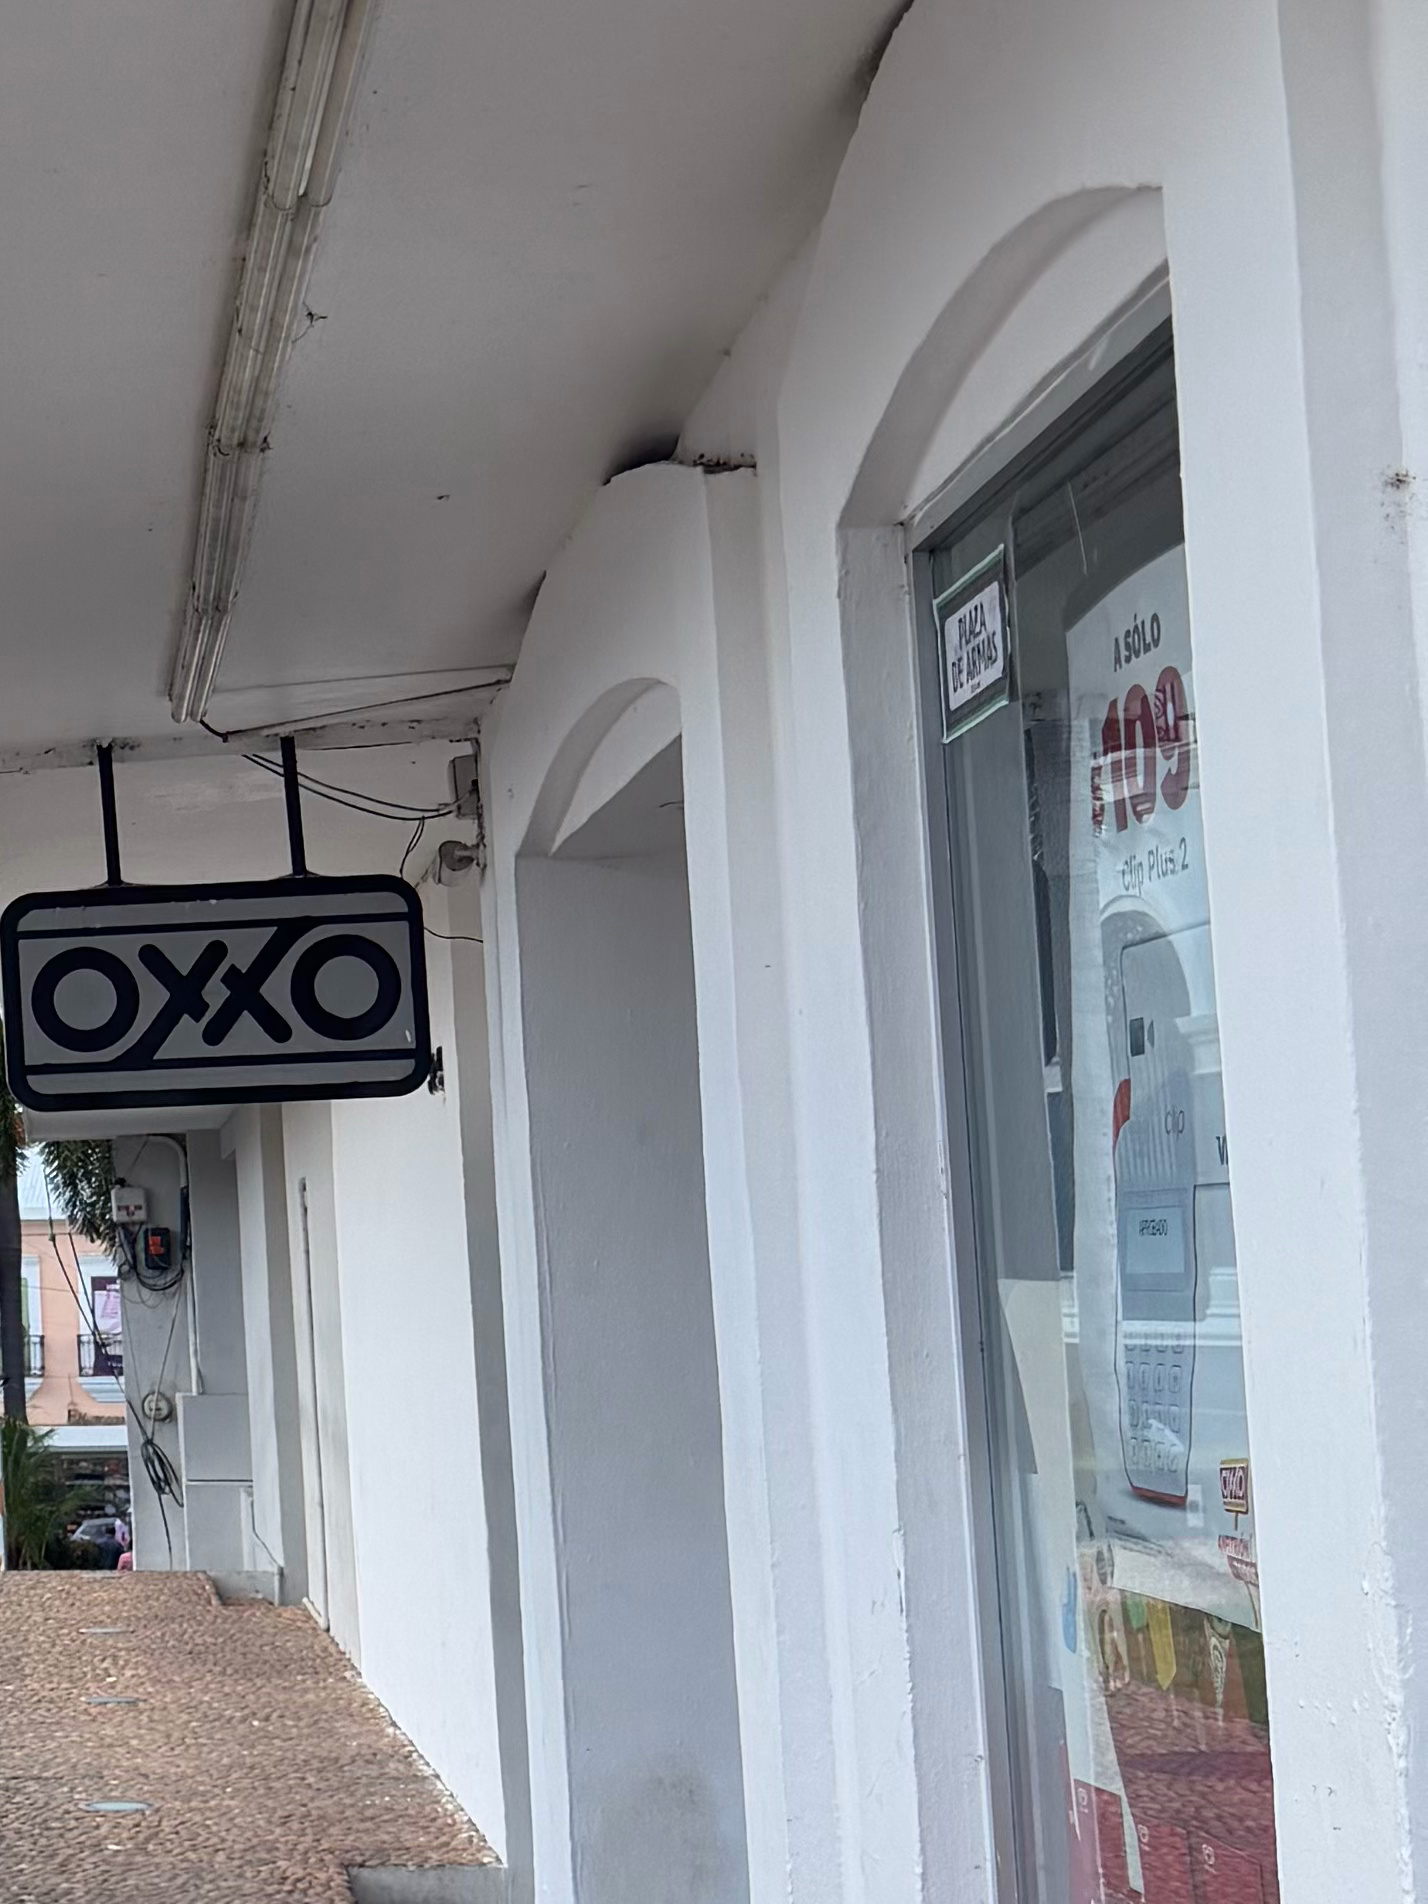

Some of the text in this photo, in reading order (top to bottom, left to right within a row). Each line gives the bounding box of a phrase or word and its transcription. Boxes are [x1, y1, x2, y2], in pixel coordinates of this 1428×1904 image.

[958, 601, 987, 652] PLAZA
[1113, 612, 1162, 673] A SÓLO
[951, 630, 998, 693] DE ARMAS
[1147, 844, 1176, 882] Plus
[1179, 836, 1189, 871] 2
[31, 928, 402, 1059] OXXO
